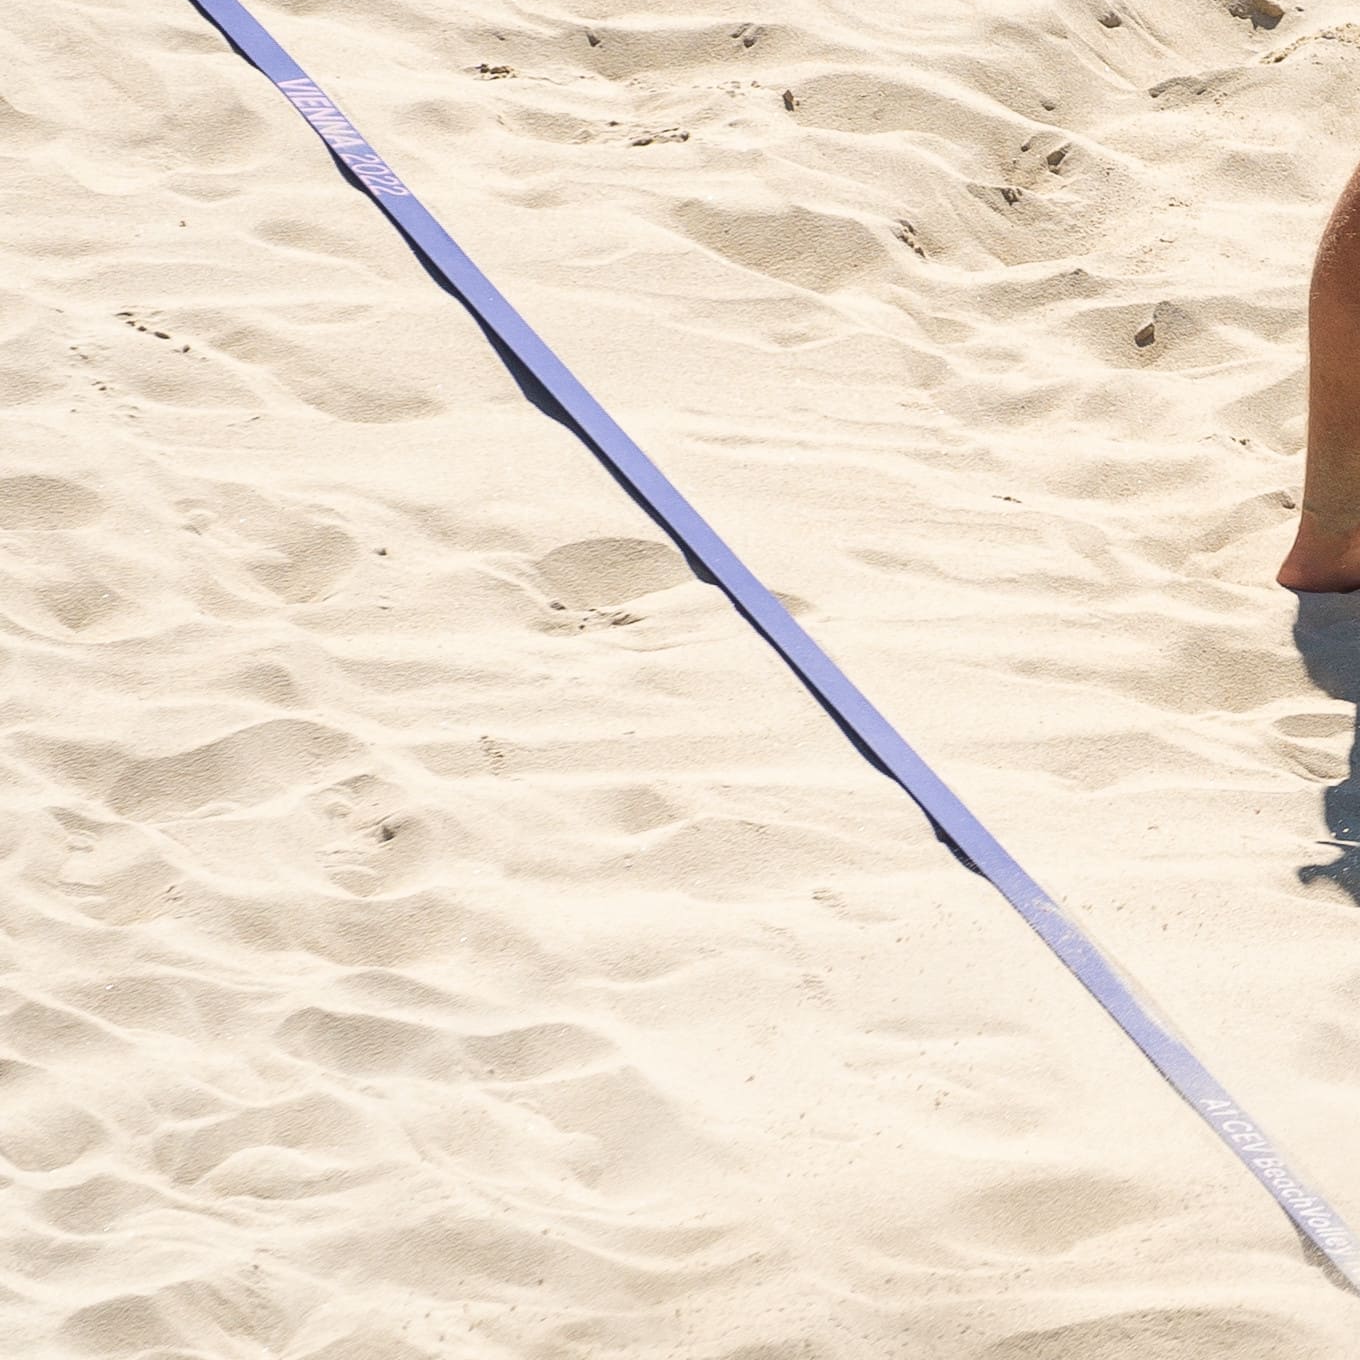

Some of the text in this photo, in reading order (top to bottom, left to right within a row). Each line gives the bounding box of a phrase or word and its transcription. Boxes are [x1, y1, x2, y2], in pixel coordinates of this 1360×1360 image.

[276, 77, 411, 197] VIENNA 2022
[1221, 1119, 1268, 1153] CEV
